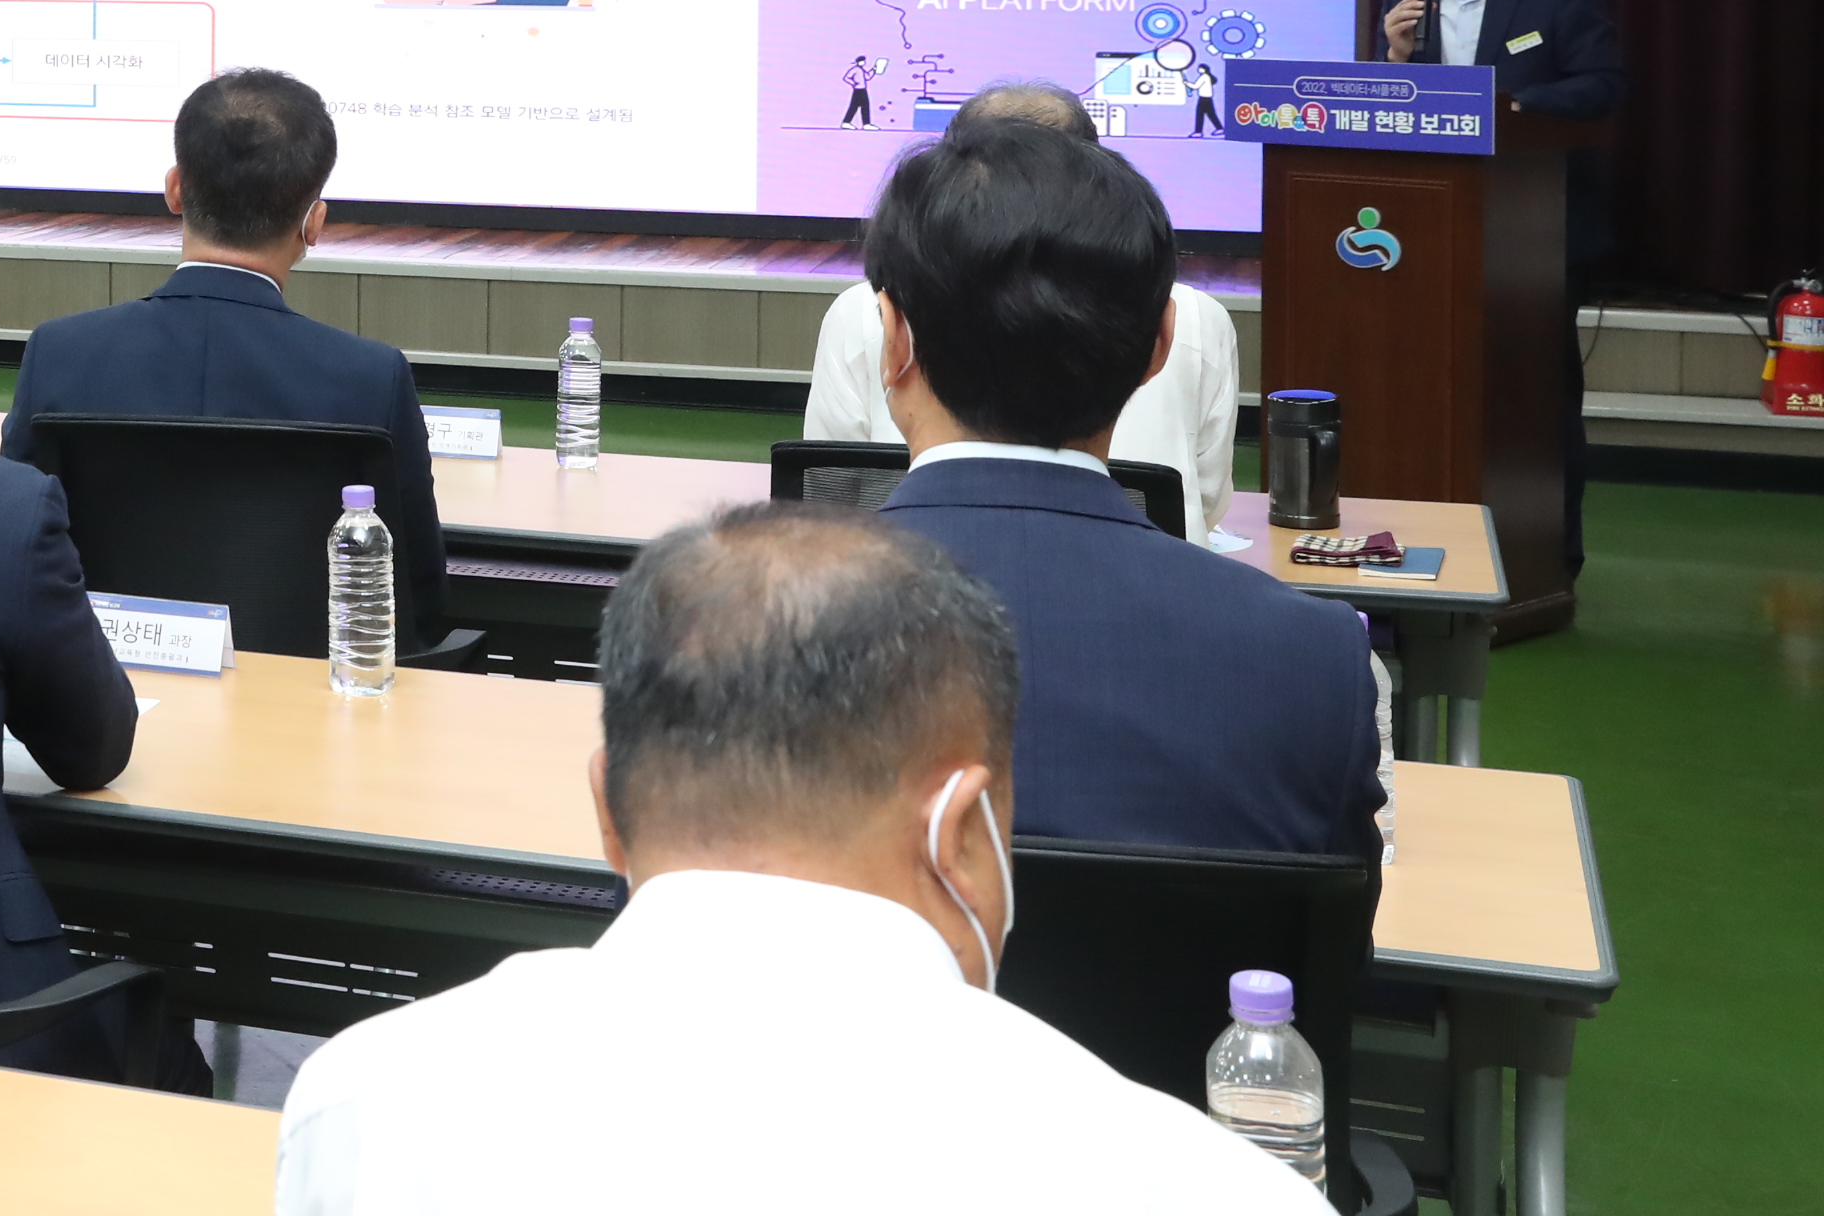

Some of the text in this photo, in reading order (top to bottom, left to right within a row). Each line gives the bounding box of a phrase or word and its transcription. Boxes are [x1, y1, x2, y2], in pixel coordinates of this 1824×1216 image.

[45, 53, 143, 70] 데이터 시각화
[518, 105, 580, 121] 기반으로
[1234, 101, 1481, 137] 아이톡톡 개발 현황 보고회
[169, 634, 192, 648] 과장
